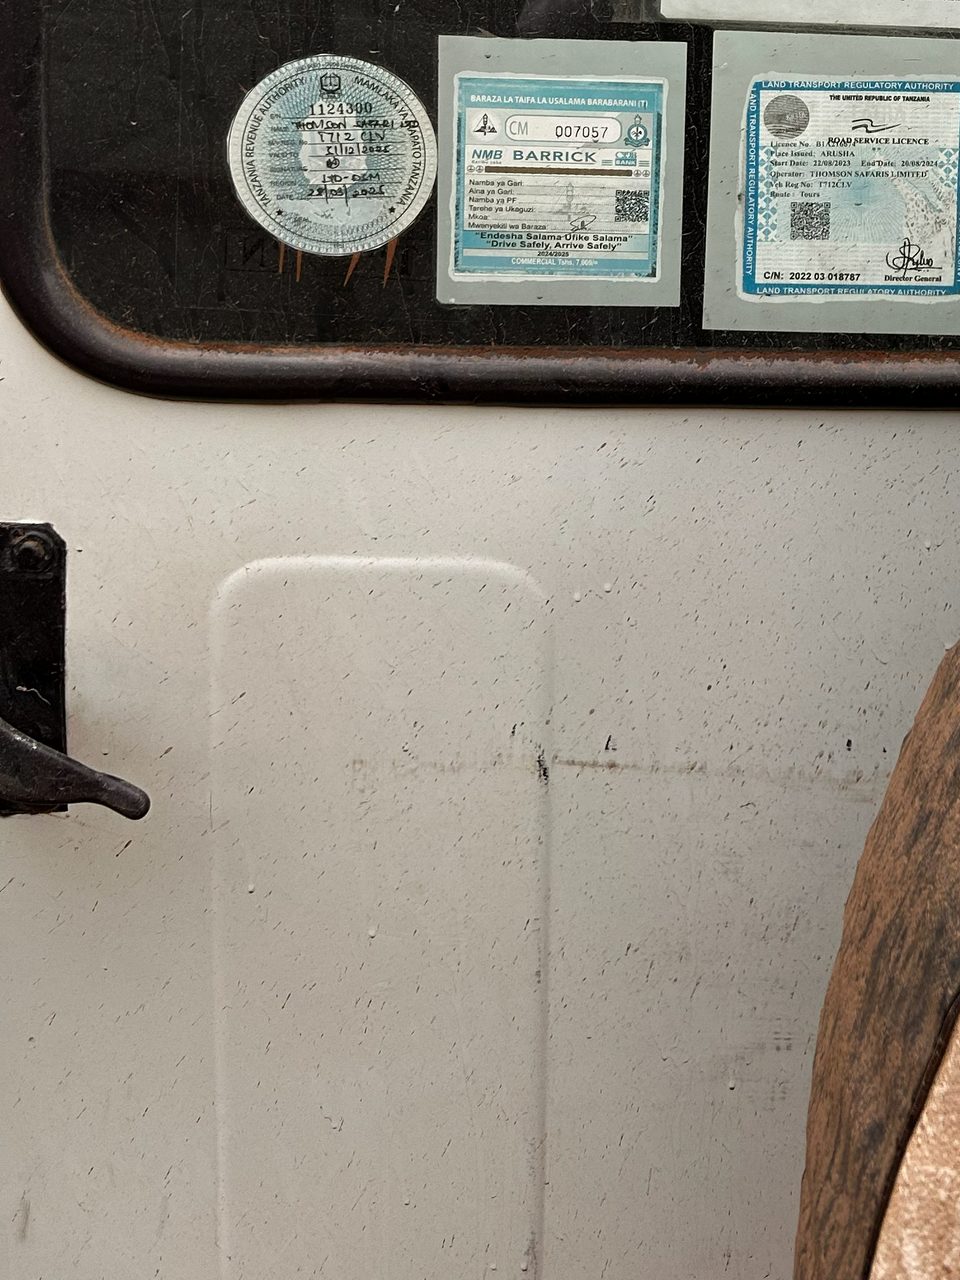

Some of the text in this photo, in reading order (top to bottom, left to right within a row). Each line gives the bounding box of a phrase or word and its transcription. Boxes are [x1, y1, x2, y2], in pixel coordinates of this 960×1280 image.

[844, 81, 903, 90] REGULATORY
[515, 96, 536, 104] TAIFA
[548, 97, 586, 106] USALAMA
[587, 98, 636, 107] BARABARANI
[309, 102, 373, 116] 1124300
[246, 114, 263, 157] REVENUE
[510, 121, 608, 138] CM 007057
[854, 137, 891, 146] SERVICE
[472, 149, 502, 159] NMB
[512, 150, 597, 163] BARRICK
[247, 160, 271, 207] TANZANIA
[397, 161, 421, 205] TANZANIA
[746, 114, 757, 275] TRANSPORT REGULATORY AUTHORITY
[520, 240, 552, 250] Safely,
[511, 257, 556, 265] COMMERCIAL
[764, 272, 784, 280] C/N:
